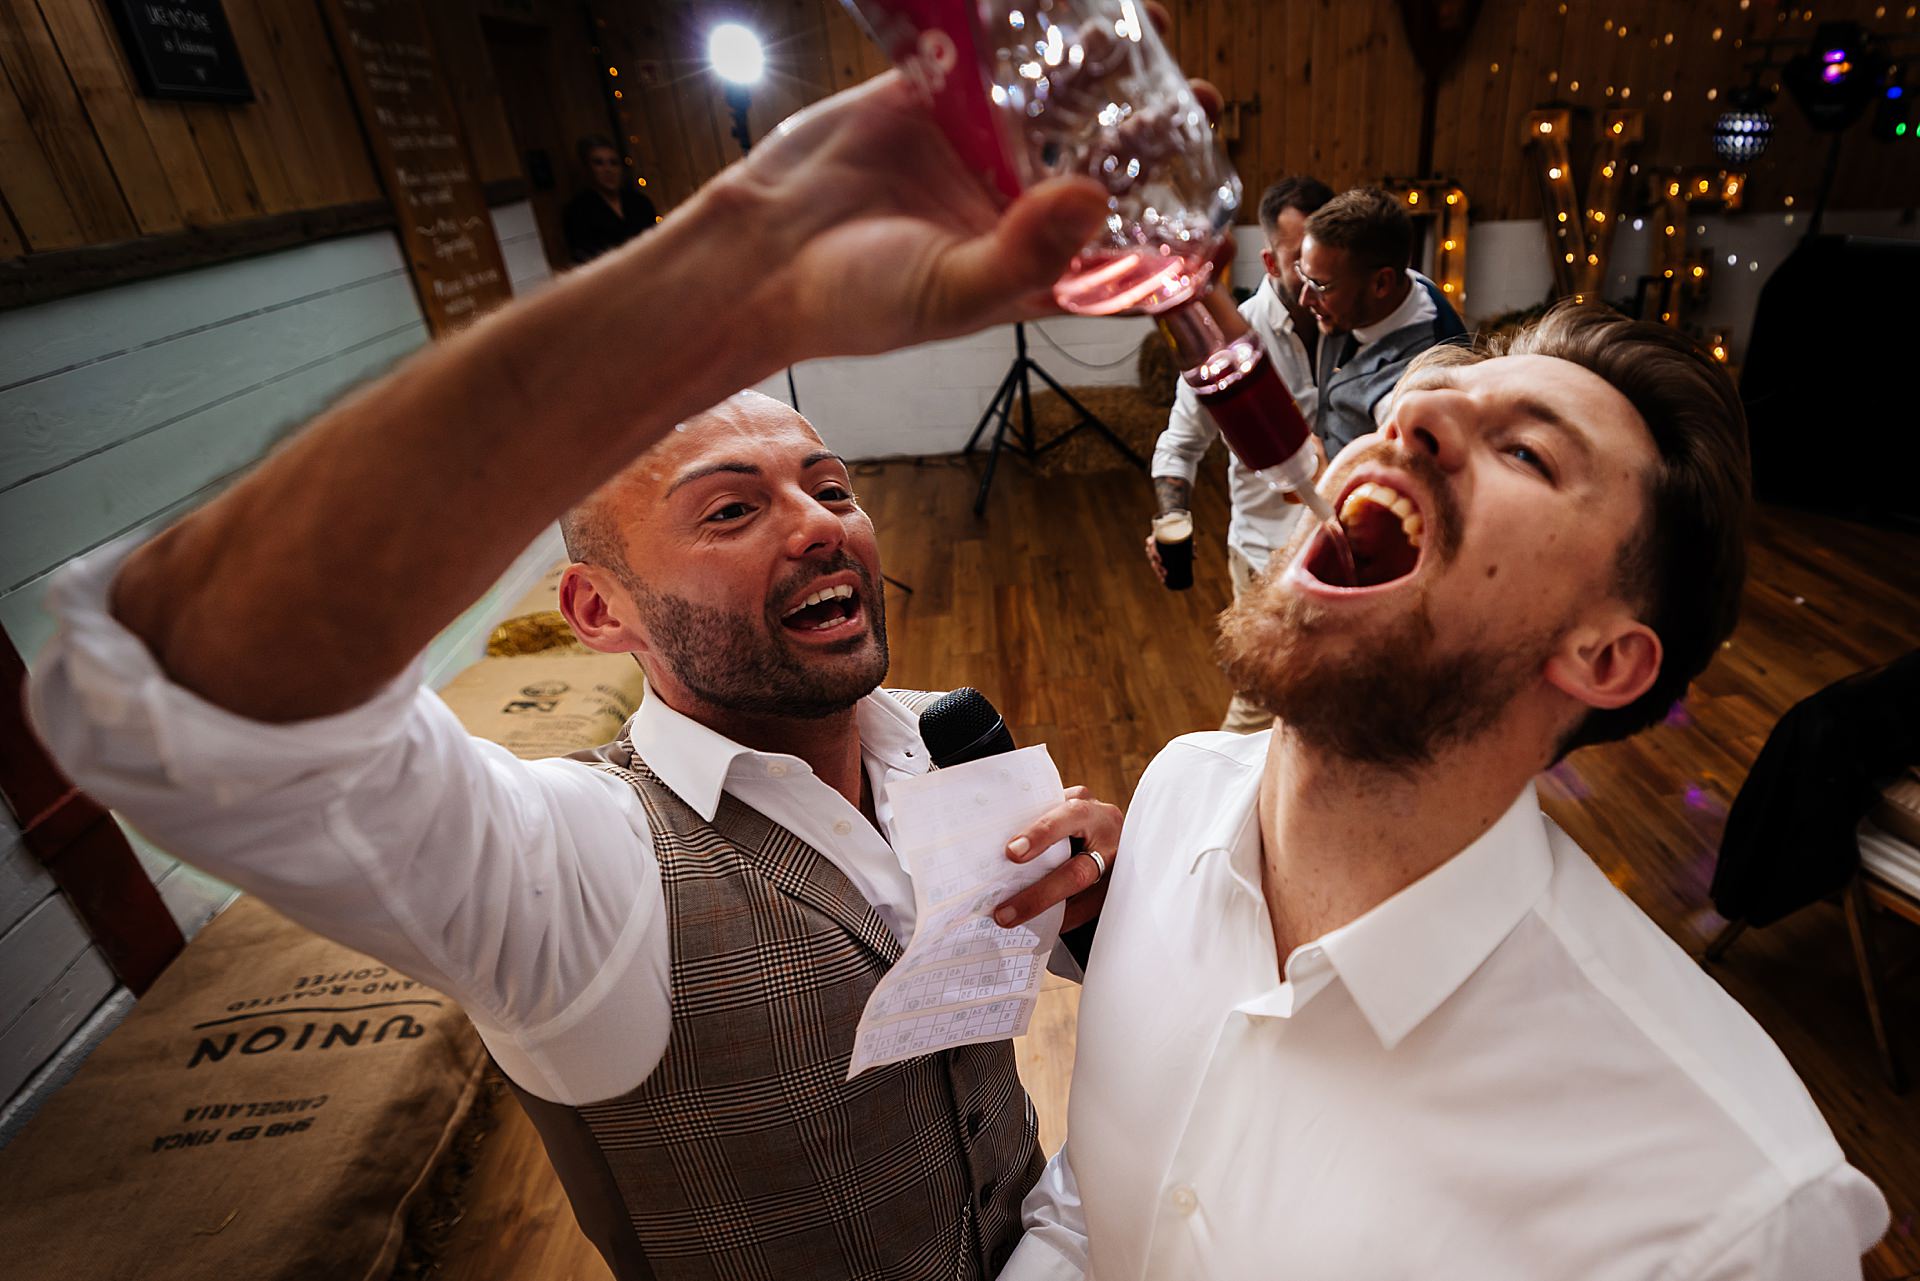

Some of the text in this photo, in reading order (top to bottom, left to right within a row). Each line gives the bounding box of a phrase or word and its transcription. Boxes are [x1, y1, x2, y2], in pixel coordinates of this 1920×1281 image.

[294, 966, 389, 990] COFFEE
[186, 1015, 424, 1069] UNION
[184, 1094, 329, 1123] CANDELARIA
[152, 1129, 222, 1153] FINCA
[225, 1125, 263, 1142] EP
